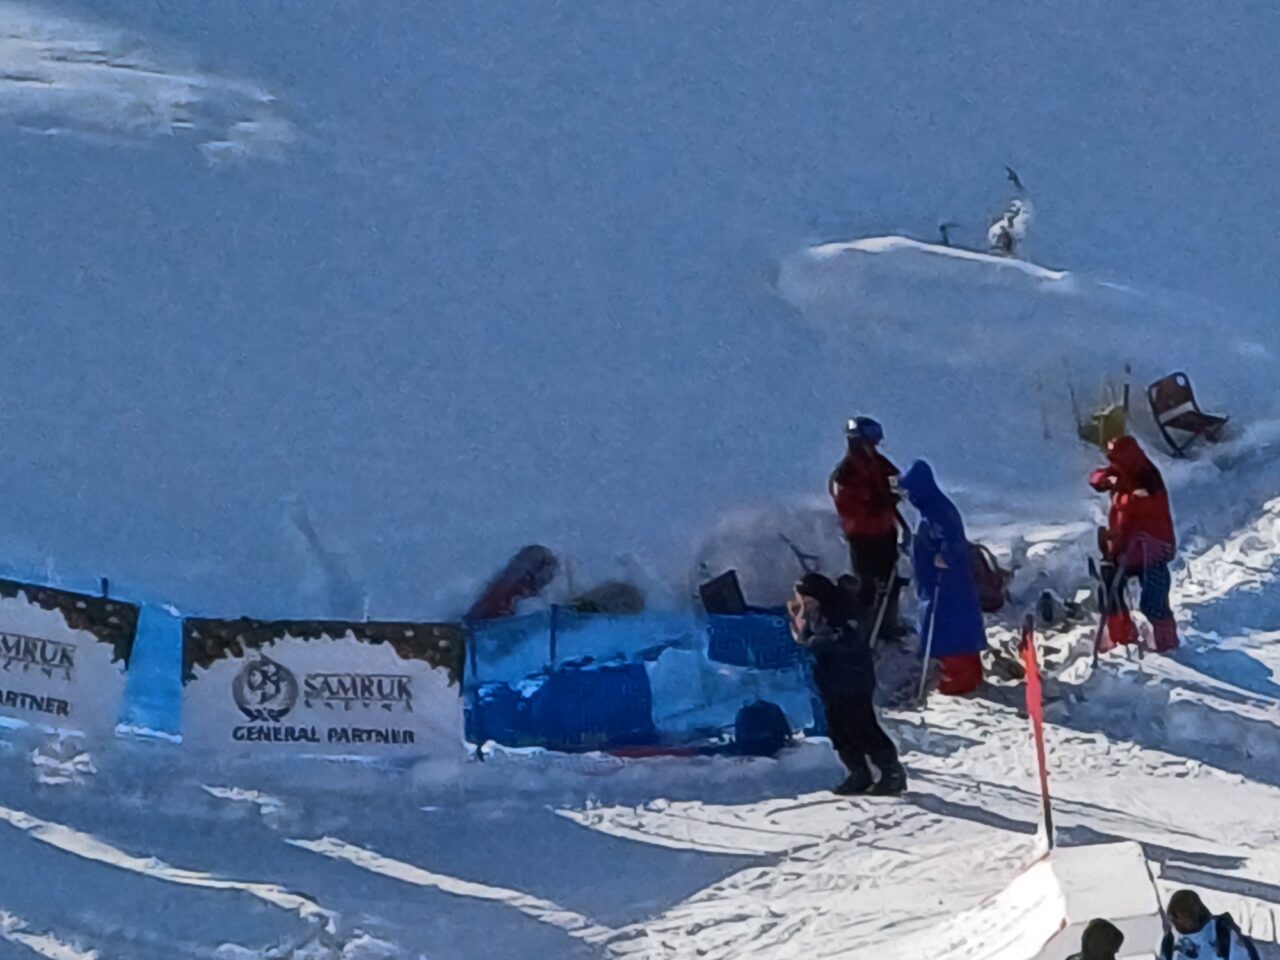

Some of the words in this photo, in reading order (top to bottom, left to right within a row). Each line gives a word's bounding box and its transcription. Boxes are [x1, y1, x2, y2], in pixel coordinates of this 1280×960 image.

[303, 673, 412, 700] SAMRUK
[232, 725, 320, 743] GENERAL
[327, 727, 415, 744] PARTNER
